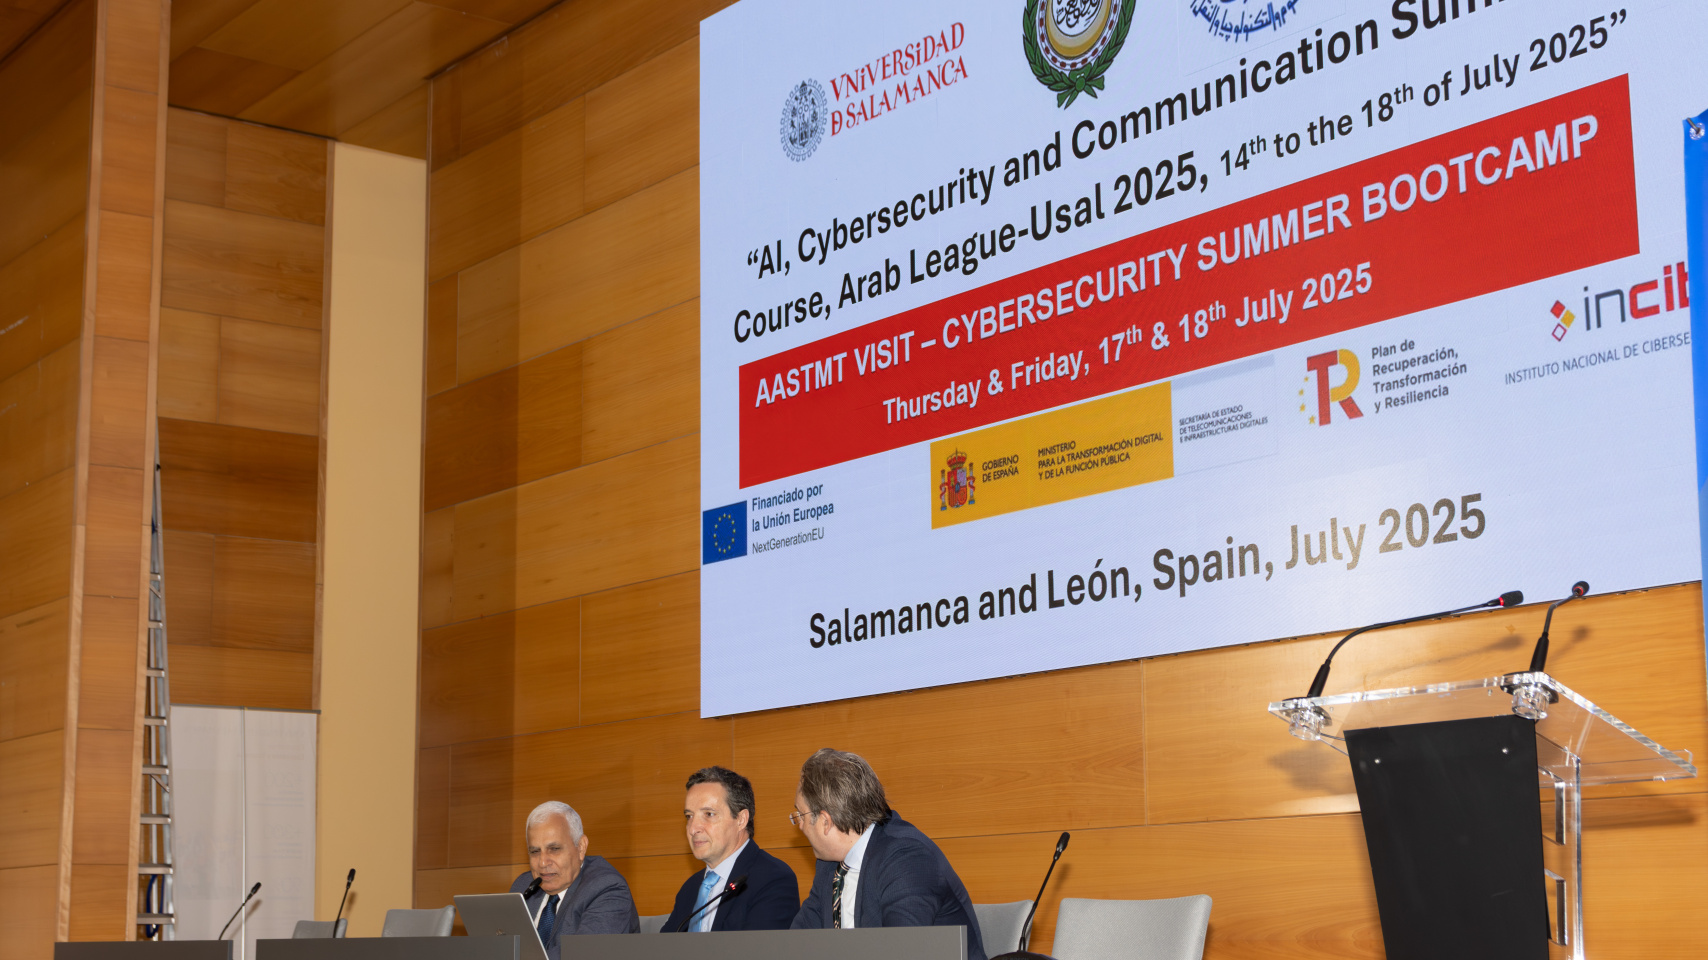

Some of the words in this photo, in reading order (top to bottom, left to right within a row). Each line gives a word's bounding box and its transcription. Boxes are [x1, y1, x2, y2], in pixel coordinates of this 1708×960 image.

[846, 55, 968, 129] SALAMANCA
[747, 240, 791, 279] “AI,
[798, 165, 996, 264] Cybersecurity
[1004, 132, 1061, 187] and
[1072, 19, 1379, 159] Communication
[733, 290, 831, 343] Course,
[839, 258, 900, 309] Arab
[911, 183, 1103, 284] League-Usal
[1113, 150, 1209, 216] 2025,
[1220, 136, 1267, 177] 14th
[1274, 129, 1301, 159] to
[1307, 113, 1354, 148] the
[1360, 83, 1415, 128] 18th
[1423, 71, 1453, 107] of
[1460, 50, 1521, 95] July
[1529, 9, 1628, 73] 2025”
[754, 353, 848, 408] AASTMT
[854, 331, 915, 376] VISIT
[942, 243, 1188, 351] CYBERSECURITY
[1197, 193, 1351, 272] SUMMER
[1361, 114, 1600, 223] BOOTCAMP
[883, 376, 981, 426] Thursday
[987, 368, 1004, 397] &
[1010, 349, 1090, 391] Friday,
[1099, 325, 1143, 366] 17th
[1151, 321, 1170, 351] &
[1178, 300, 1227, 343] 18th
[1235, 288, 1294, 329] July
[1301, 261, 1374, 311] 2025
[1371, 344, 1397, 359] Plan
[1400, 339, 1415, 353] de
[1372, 347, 1459, 376] Recuperación,
[1505, 361, 1560, 385] INSTITUTO
[1562, 349, 1620, 372] NACIONAL
[1623, 344, 1639, 359] DE
[1373, 363, 1467, 394] Transformación
[1374, 401, 1381, 414] y
[1385, 385, 1449, 409] Resiliencia
[1179, 412, 1211, 426] SECRETARÍA
[1211, 410, 1219, 418] DE
[1220, 404, 1243, 416] ESTADO
[1180, 427, 1187, 435] DE
[1188, 411, 1252, 433] TELECOMUNICACIONES
[1184, 424, 1239, 442] INFRAESTRUCTURAS
[1239, 416, 1268, 429] DIGITALES
[982, 454, 1019, 472] GOBIERNO
[1037, 440, 1076, 457] MINISTERIO
[1038, 458, 1055, 469] PARA
[1057, 455, 1066, 465] LA
[1067, 438, 1133, 461] TRANSFORMACIÓN
[1135, 432, 1164, 447] DIGITAL
[982, 472, 992, 483] DE
[993, 465, 1019, 481] ESPAÑA
[1038, 472, 1043, 480] Y
[1044, 469, 1054, 480] DE
[1055, 467, 1064, 477] LA
[1065, 458, 1099, 475] FUNCIÓN
[1100, 451, 1131, 467] PÚBLICA
[752, 487, 804, 512] Financiado
[806, 484, 823, 502] por
[752, 518, 760, 532] la
[762, 511, 791, 530] Unión
[793, 503, 834, 523] Europea
[752, 527, 825, 554] NextGenerationEU
[809, 595, 969, 649] Salamanca
[979, 573, 1037, 620] and
[1047, 558, 1142, 609] León,
[1153, 536, 1274, 597] Spain,
[1285, 516, 1366, 571] July
[1378, 492, 1486, 554] 2025
